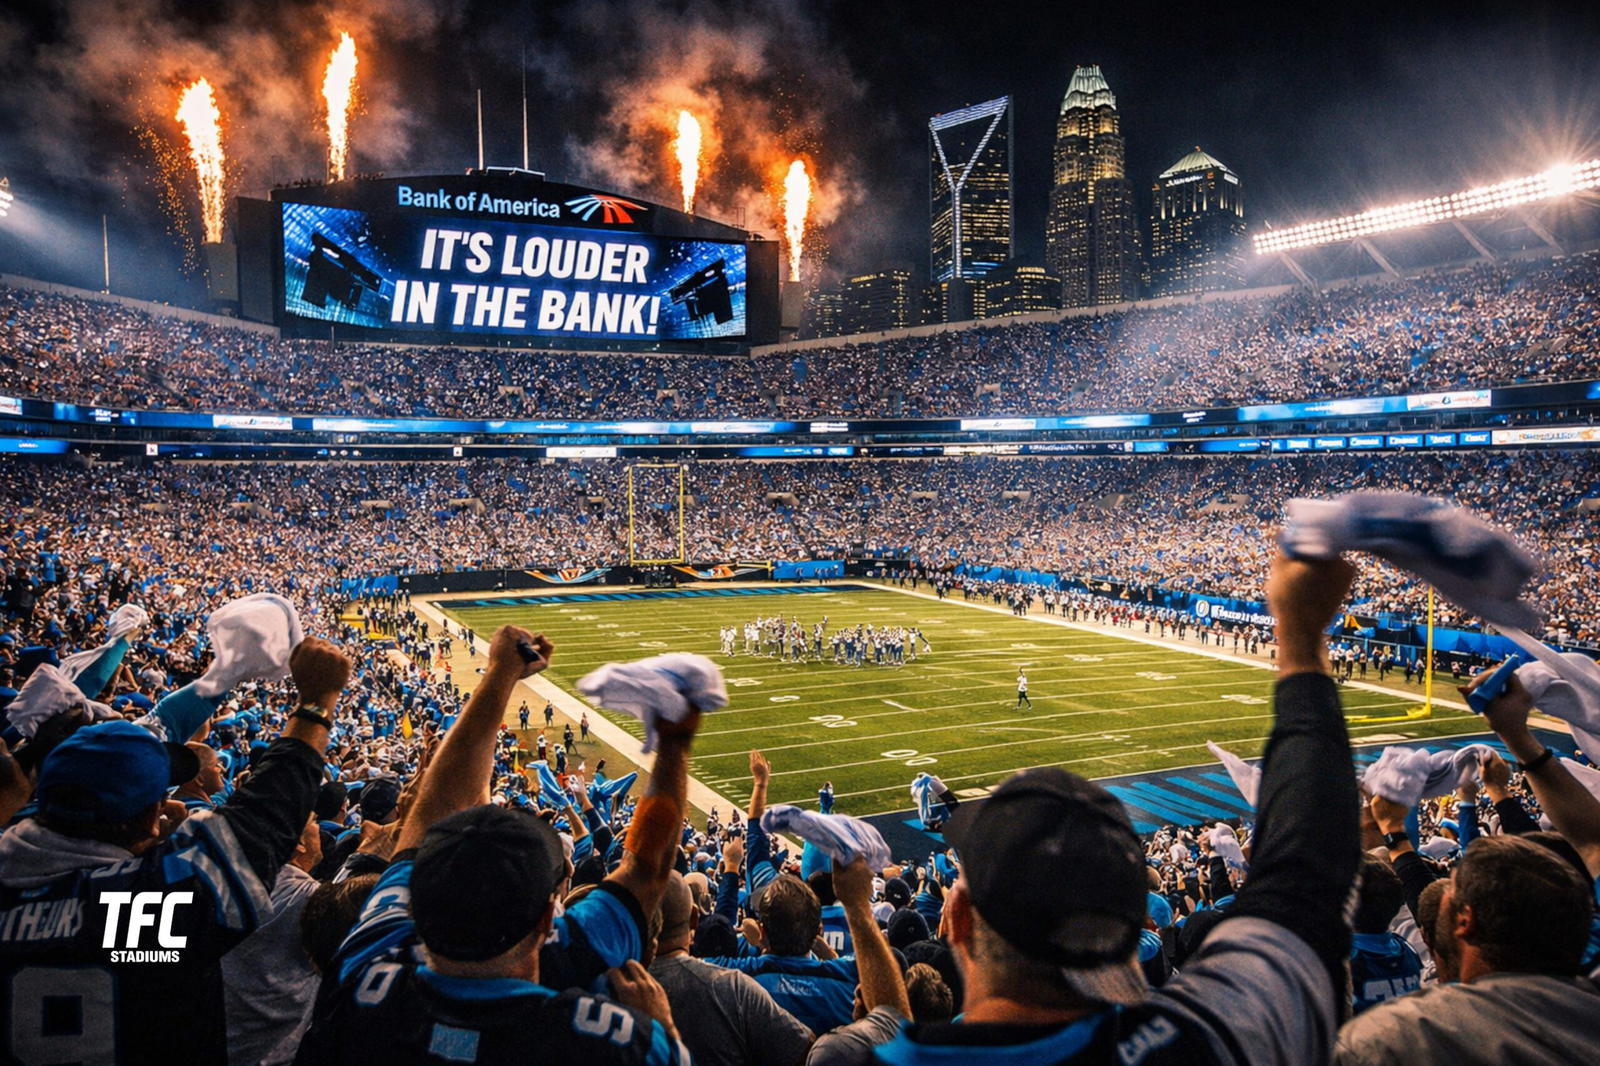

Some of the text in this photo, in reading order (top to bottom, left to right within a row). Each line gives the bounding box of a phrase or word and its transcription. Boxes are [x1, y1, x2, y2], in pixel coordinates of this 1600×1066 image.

[398, 185, 561, 219] Bank of America
[421, 228, 650, 284] IT'S LOUDER
[390, 279, 661, 335] IN THE BANK!
